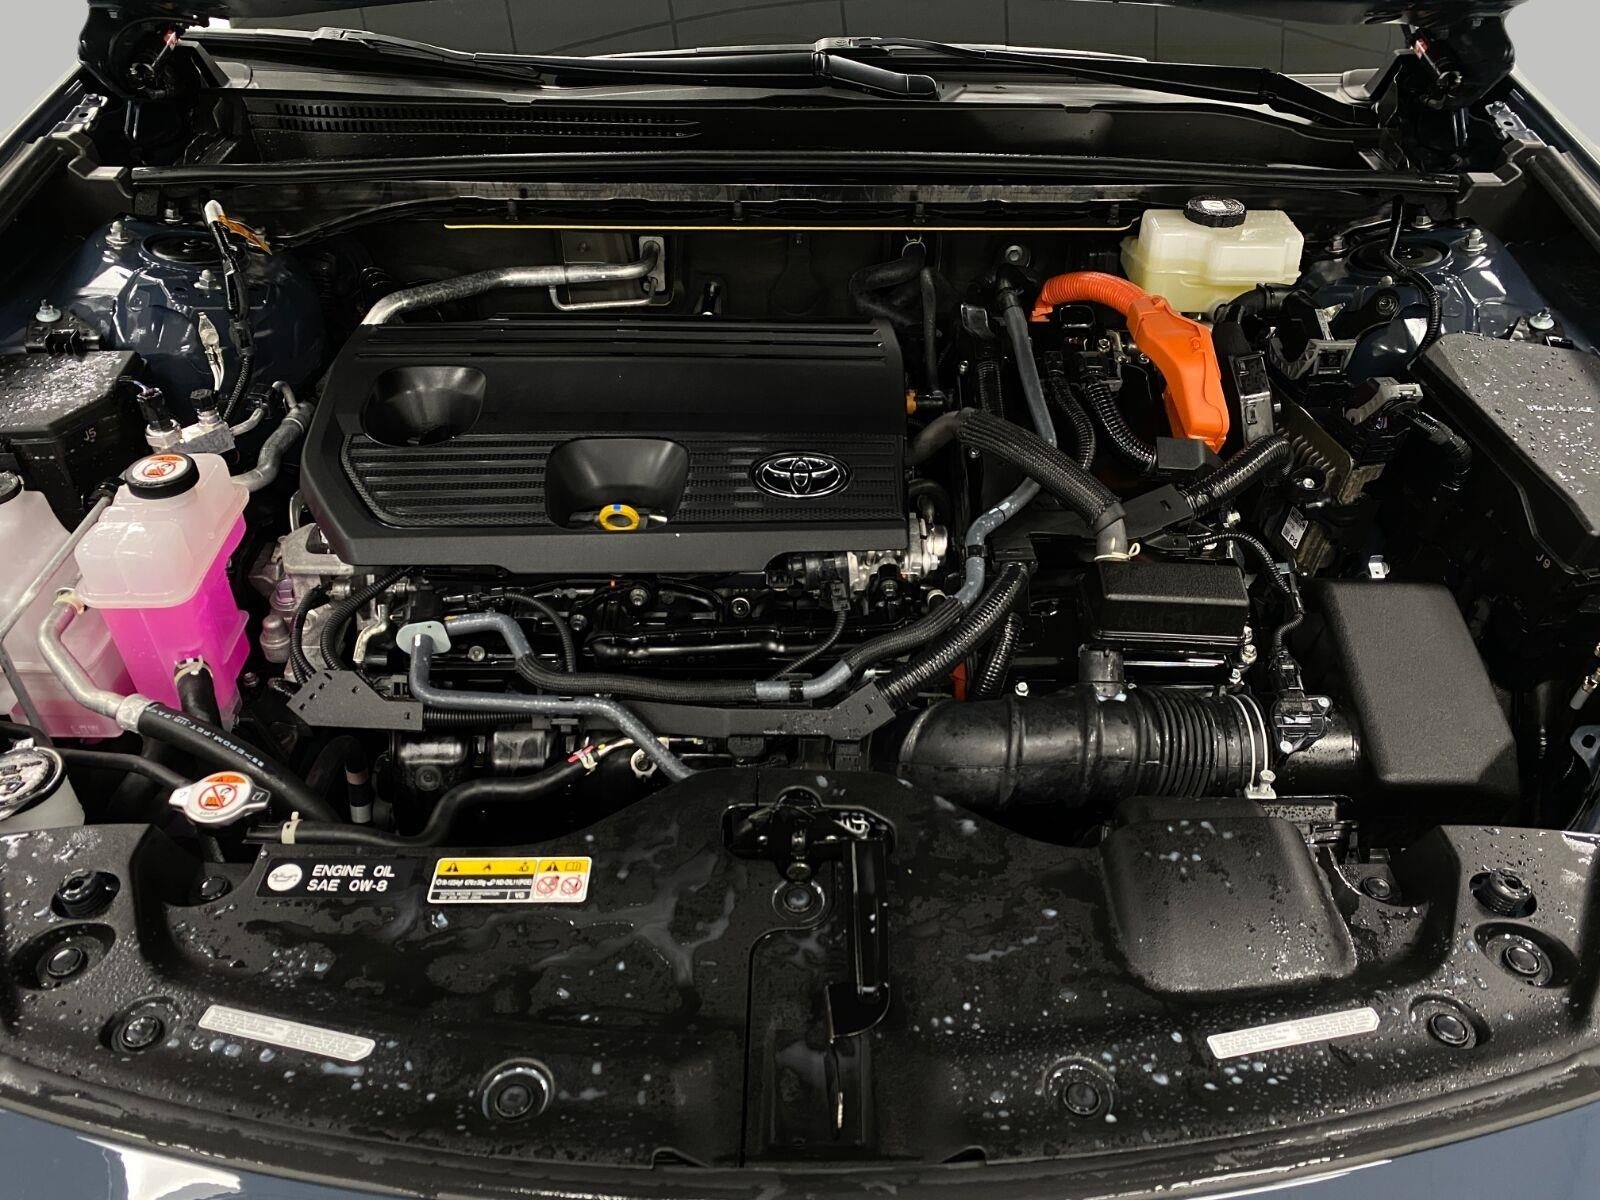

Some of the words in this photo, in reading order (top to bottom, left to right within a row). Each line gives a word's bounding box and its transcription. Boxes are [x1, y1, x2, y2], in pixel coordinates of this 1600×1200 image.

[312, 864, 366, 877] ENGINE
[373, 865, 395, 878] OIL
[306, 879, 341, 892] SAE
[348, 879, 388, 892] 0W-8
